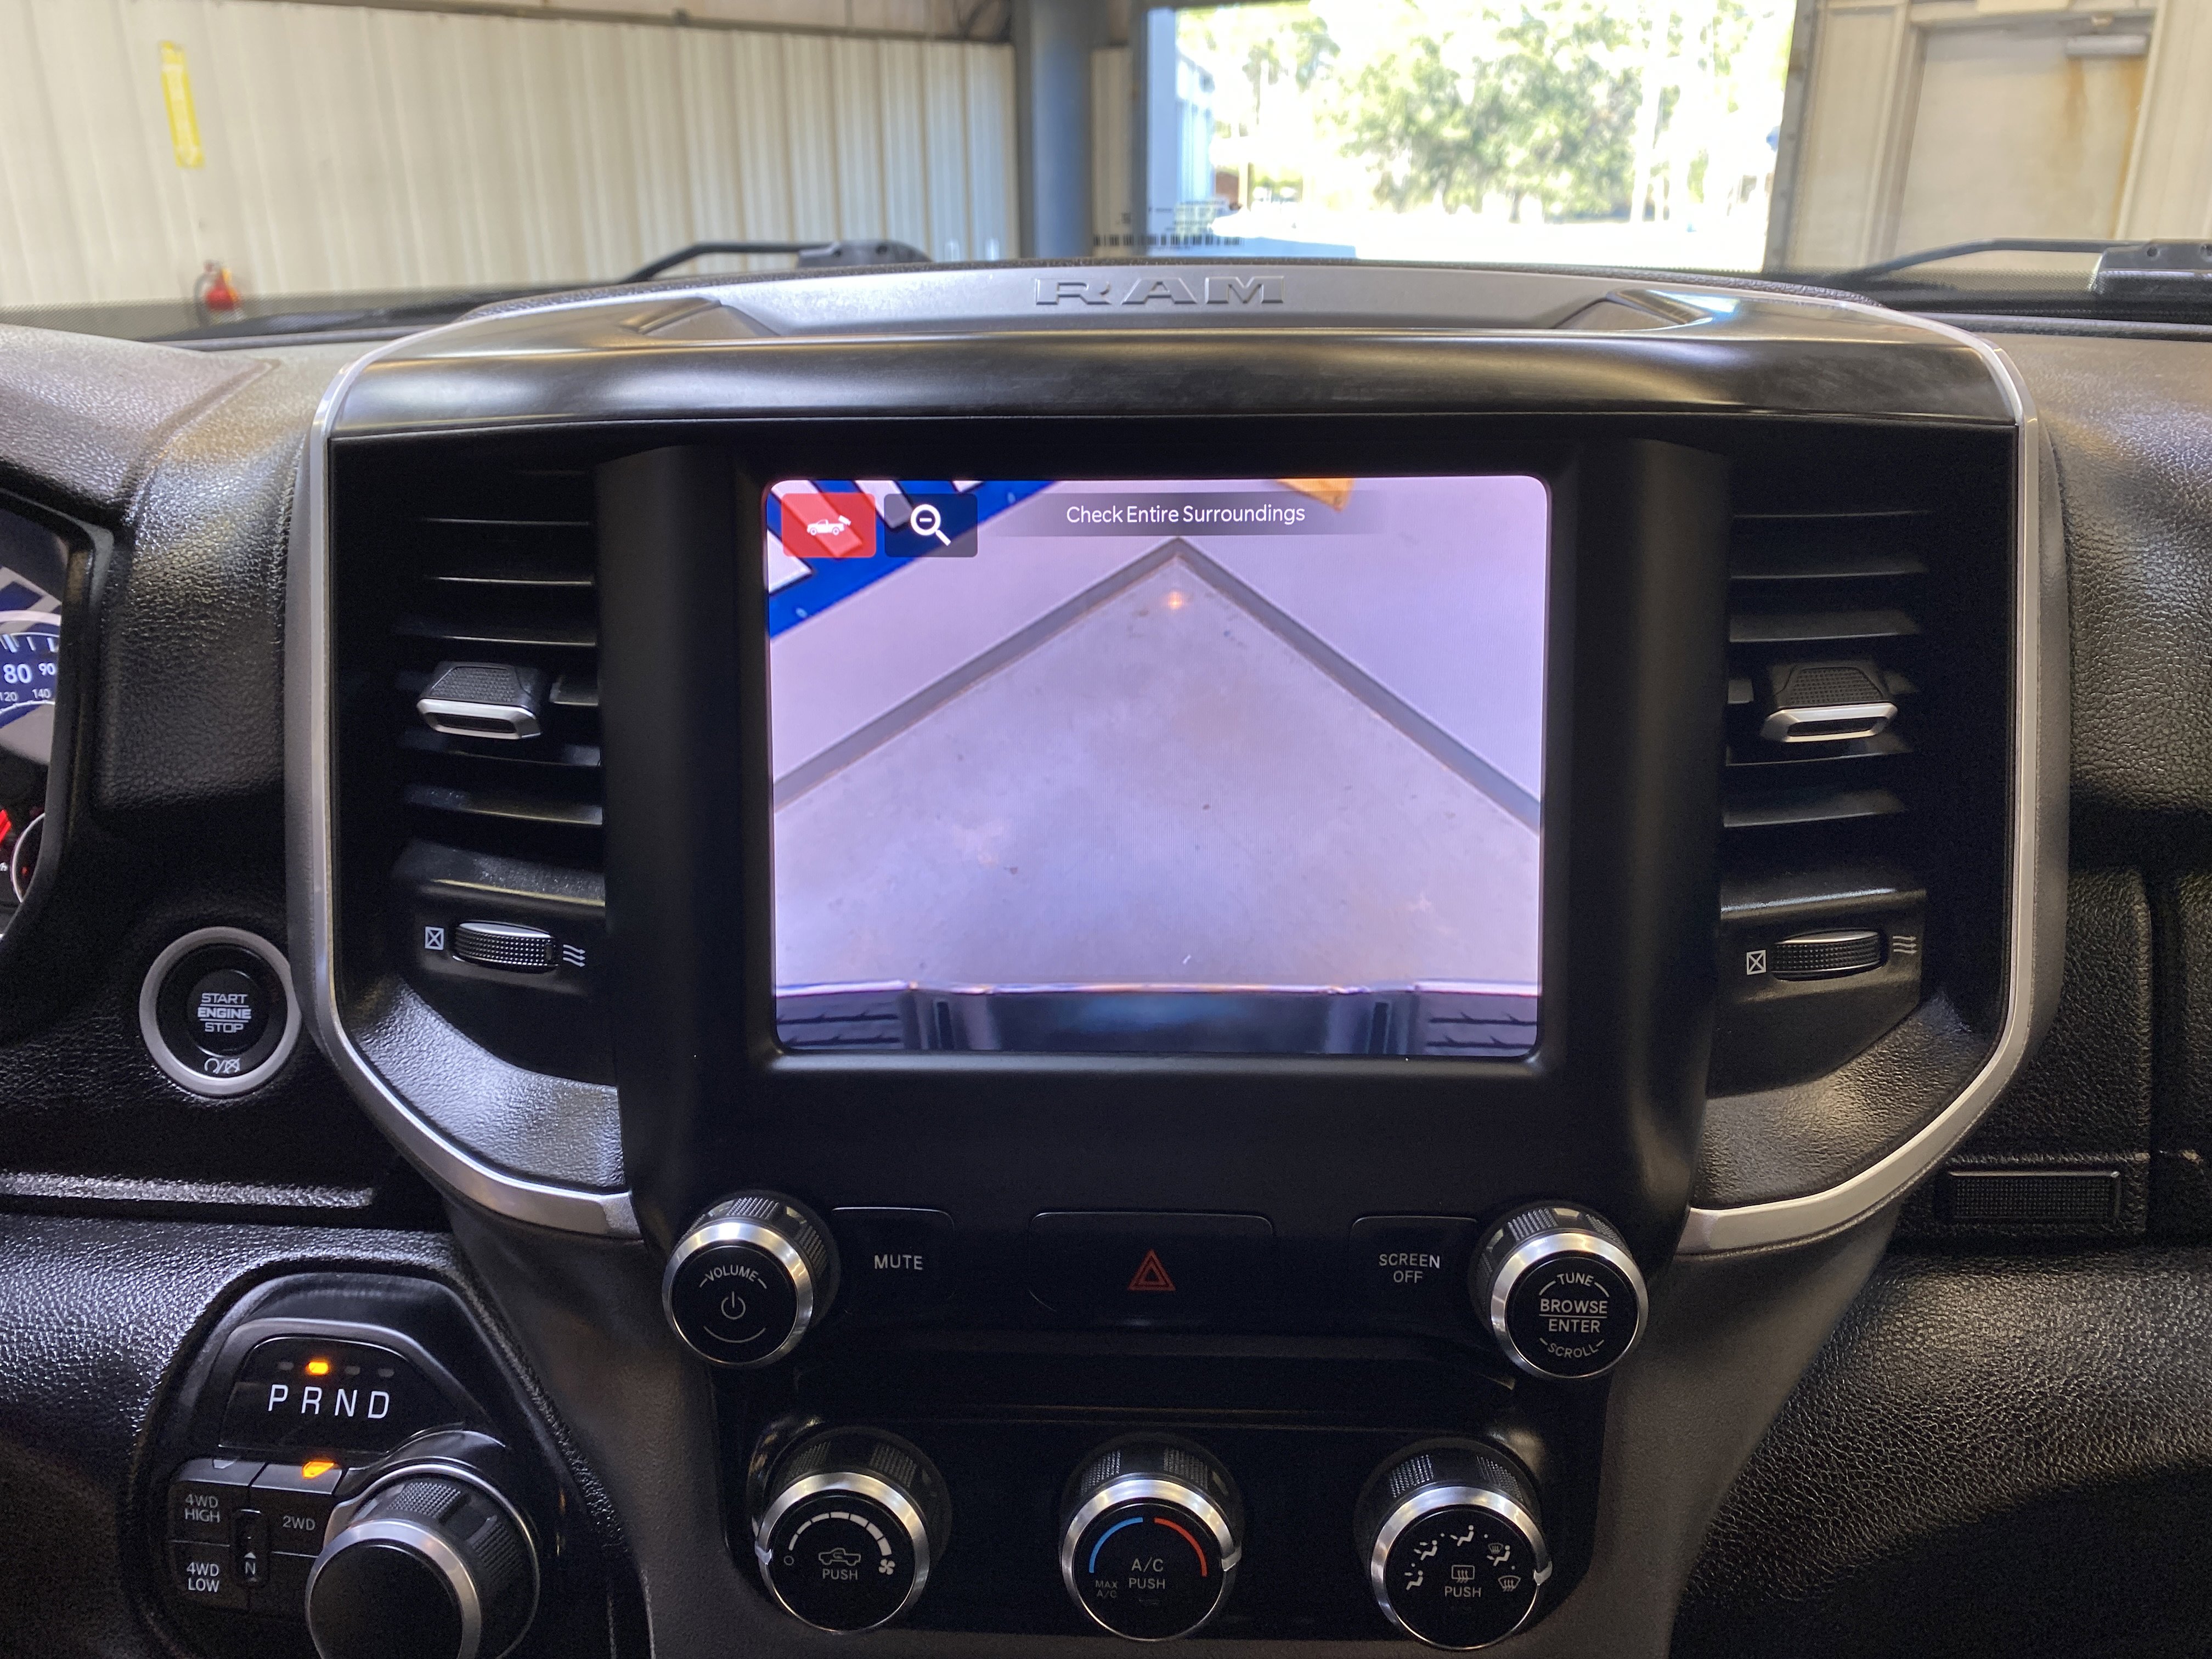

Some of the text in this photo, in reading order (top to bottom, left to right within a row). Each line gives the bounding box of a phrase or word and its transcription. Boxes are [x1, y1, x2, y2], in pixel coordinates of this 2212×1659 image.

[1035, 275, 1285, 305] RAM
[1066, 504, 1305, 525] Check Entire Surroundings
[3, 662, 57, 683] 80 90
[32, 688, 51, 699] 140
[201, 993, 247, 1004] START
[198, 1007, 252, 1019] ENGINE
[205, 1023, 243, 1032] STOP
[874, 1254, 923, 1271] MUTE
[1379, 1253, 1441, 1269] SCREEN
[704, 1265, 759, 1282] VOLUME
[1392, 1271, 1423, 1283] OFF
[1557, 1272, 1594, 1287] TUNE
[1540, 1298, 1608, 1314] BROWSE
[1548, 1318, 1600, 1333] ENTER
[1548, 1343, 1599, 1358] SCROLL
[185, 1494, 219, 1508] 4WD
[185, 1509, 219, 1522] HIGH
[282, 1516, 316, 1531] 2WD
[186, 1561, 219, 1577] 4WD
[245, 1561, 256, 1574] N
[1131, 1557, 1164, 1573] A/C
[822, 1569, 857, 1580] PUSH
[187, 1577, 219, 1593] LOW
[1095, 1580, 1118, 1589] MAX
[1128, 1578, 1166, 1589] PUSH
[1097, 1590, 1117, 1598] A/C
[1444, 1585, 1482, 1598] PUSH
